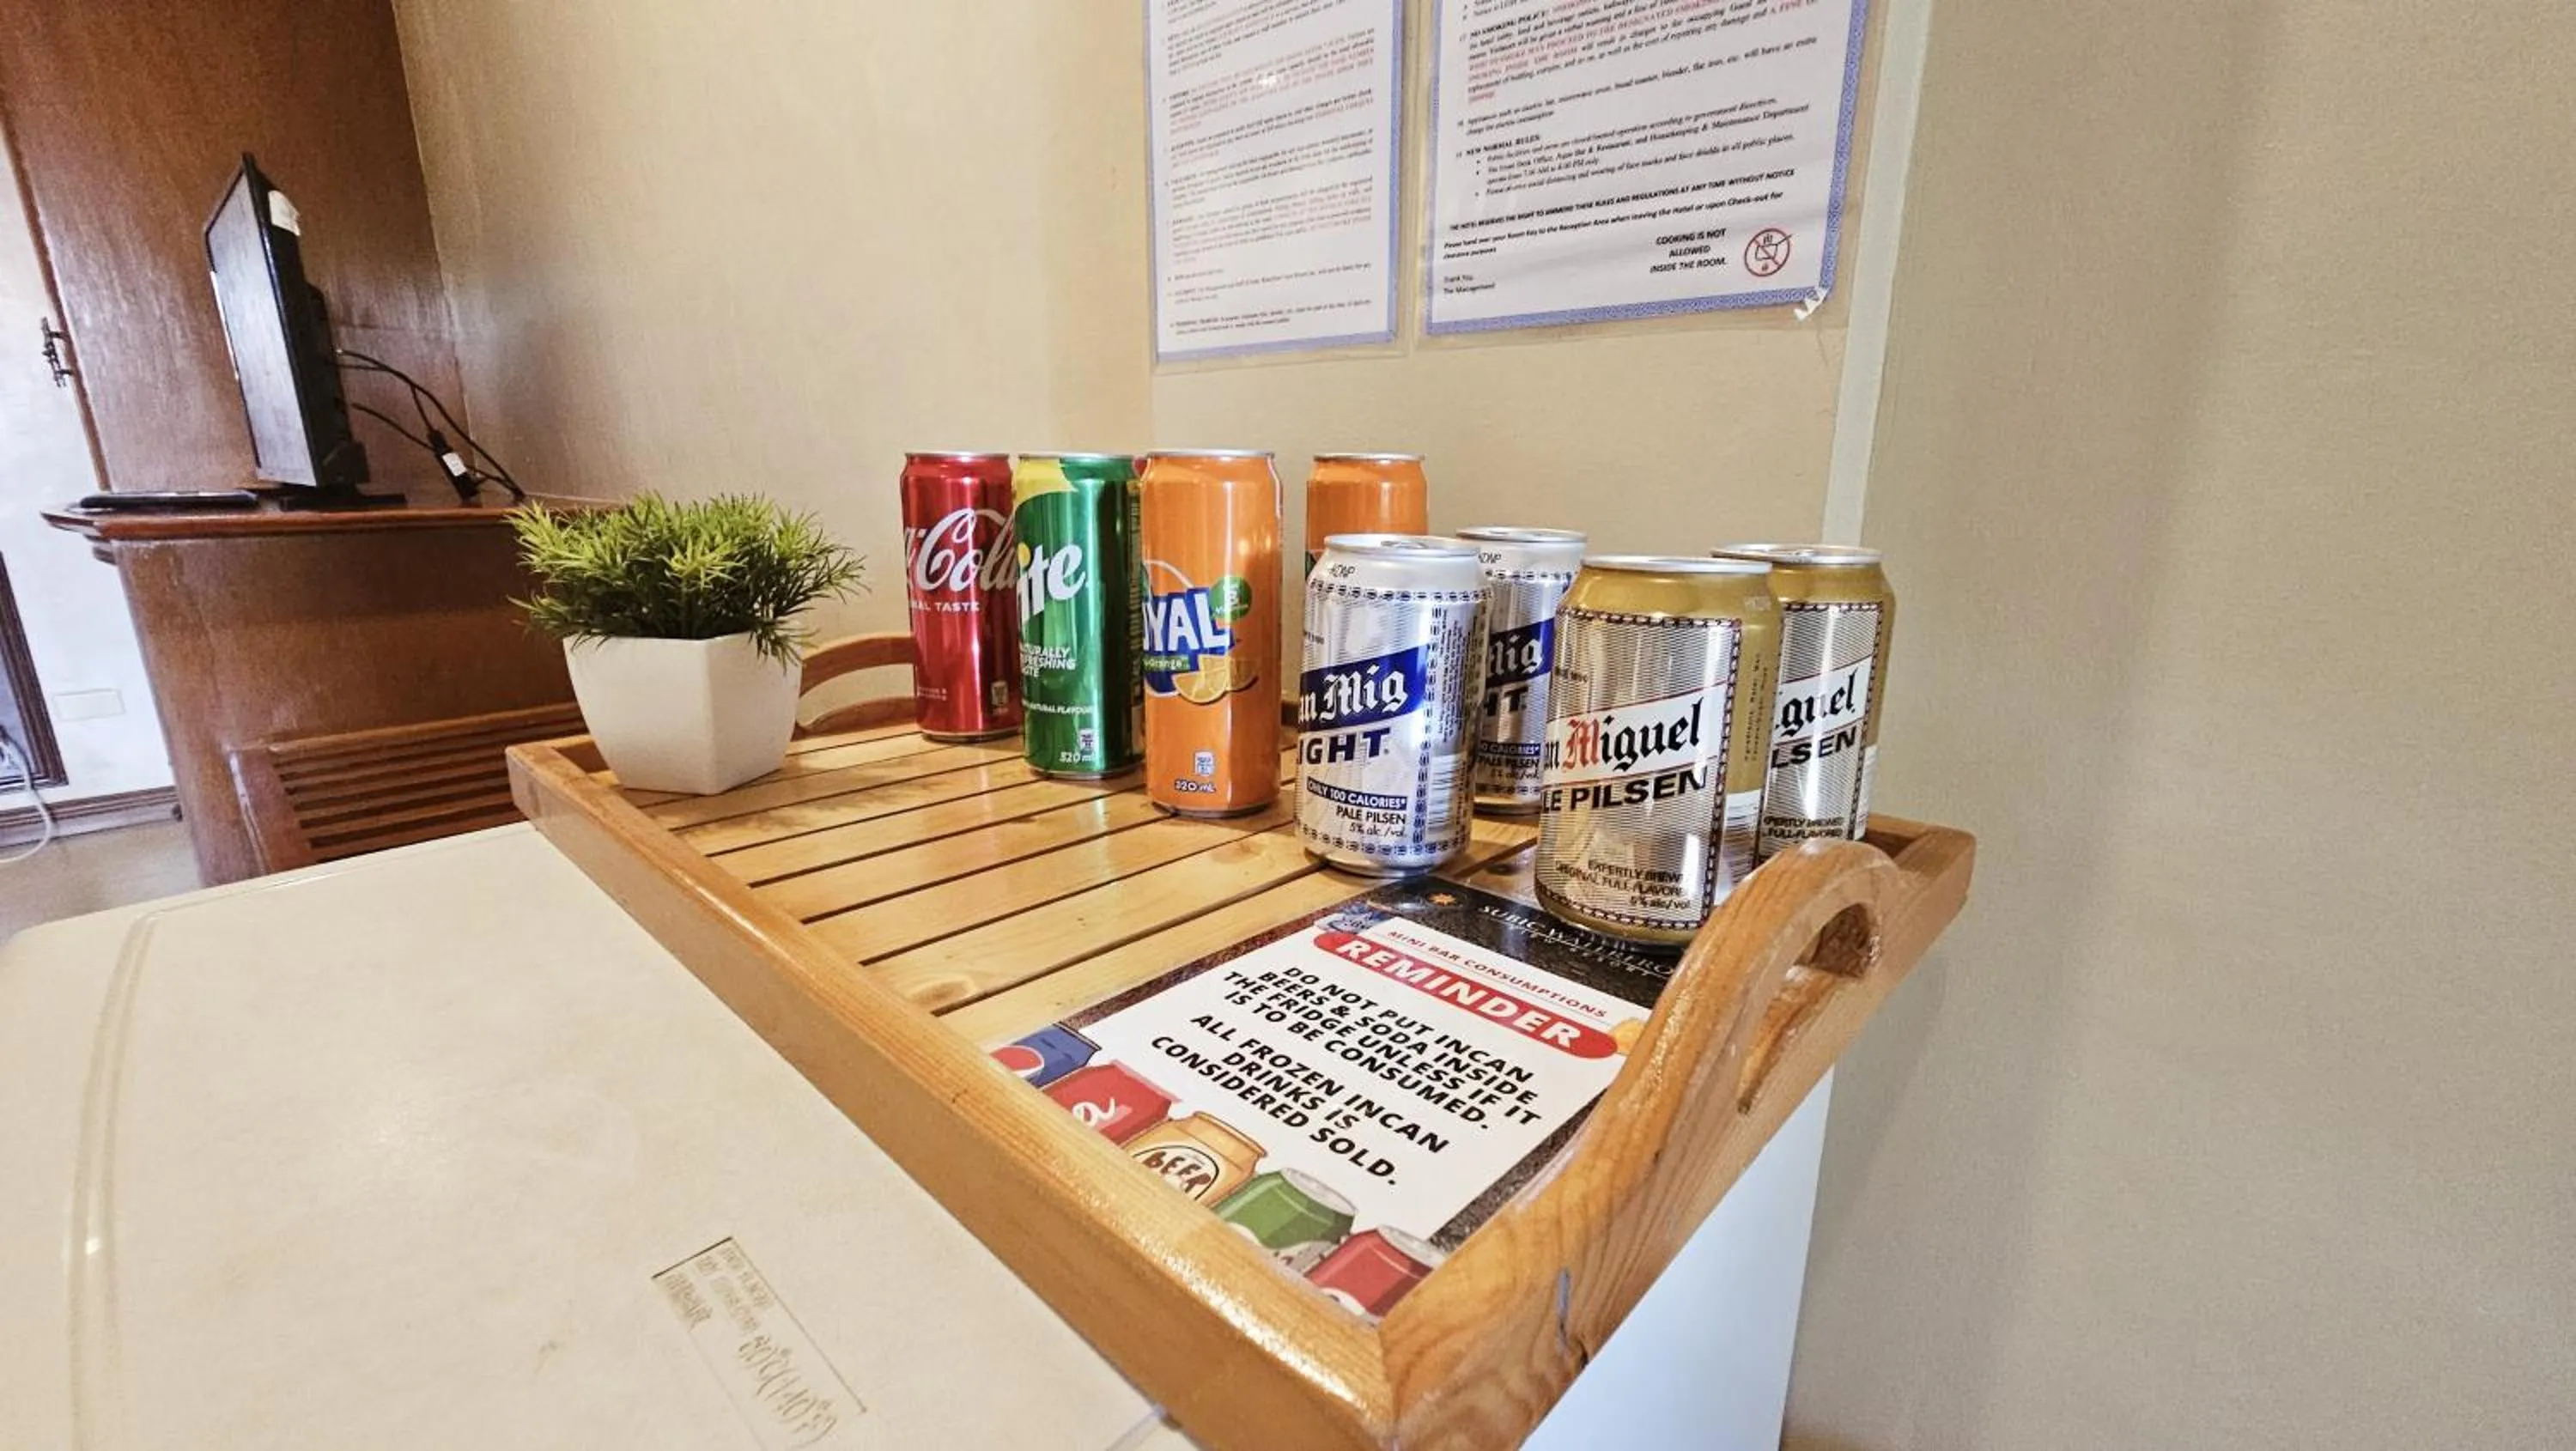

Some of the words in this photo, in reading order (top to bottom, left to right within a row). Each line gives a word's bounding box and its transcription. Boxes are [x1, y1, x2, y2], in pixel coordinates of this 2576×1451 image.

[1631, 186, 1678, 202] REGULATIONS
[1692, 183, 1706, 192] ANY
[1708, 179, 1726, 189] TIME
[1728, 173, 1764, 186] WITHOUT
[1765, 168, 1795, 180] NOTICE
[1659, 206, 1670, 216] the
[1673, 204, 1693, 214] Hotel
[1706, 200, 1726, 210] upon
[1728, 193, 1768, 206] Check-out
[1649, 262, 1676, 273] INSIDE
[1679, 260, 1694, 270] THE
[1656, 233, 1696, 246] COOKING
[1697, 232, 1704, 240] IS
[1706, 228, 1726, 239] NOT
[1668, 245, 1710, 258] ALLOWED
[934, 602, 981, 613] TASTE
[1142, 592, 1230, 652] YAL
[1319, 664, 1409, 723] Mig
[1562, 696, 1704, 772] Miguel
[1308, 780, 1328, 798] ONLY
[1329, 788, 1346, 801] 100
[1336, 805, 1363, 822] PALE
[1365, 811, 1407, 825] PILSEN
[1570, 765, 1708, 811] PILSEN
[1349, 822, 1364, 835] 5%
[1335, 940, 1582, 1048] REMINDER
[1387, 930, 1427, 948] MINI
[1428, 945, 1462, 962] BAR
[1464, 959, 1608, 1017] CONSUMPTIONS
[1224, 971, 1270, 995] THE
[1267, 992, 1357, 1038] FRIDGE
[1358, 1035, 1466, 1090] UNLESS
[1467, 1088, 1502, 1106] IF
[1504, 1105, 1543, 1126] IT
[1257, 971, 1331, 1006] BEERS
[1330, 1005, 1351, 1018] &
[1354, 1016, 1429, 1055] SODA
[1432, 1052, 1539, 1105] INSIDE
[1282, 967, 1320, 985] DO
[1321, 983, 1378, 1011] NOT
[1377, 1009, 1436, 1035] PUT
[1434, 1035, 1534, 1083] INCAN
[1189, 1015, 1237, 1041] ALL
[1238, 1037, 1346, 1097] FROZEN
[1344, 1094, 1449, 1153] INCAN
[1224, 990, 1254, 1005] IS
[1252, 1002, 1287, 1023] TO
[1287, 1021, 1325, 1042] BE
[1324, 1040, 1488, 1129] CONSUMED.
[1151, 1036, 1309, 1127] CONSIDERED
[1309, 1127, 1397, 1186] SOLD.
[1221, 1052, 1327, 1110] DRINKS
[1324, 1108, 1361, 1130] IS
